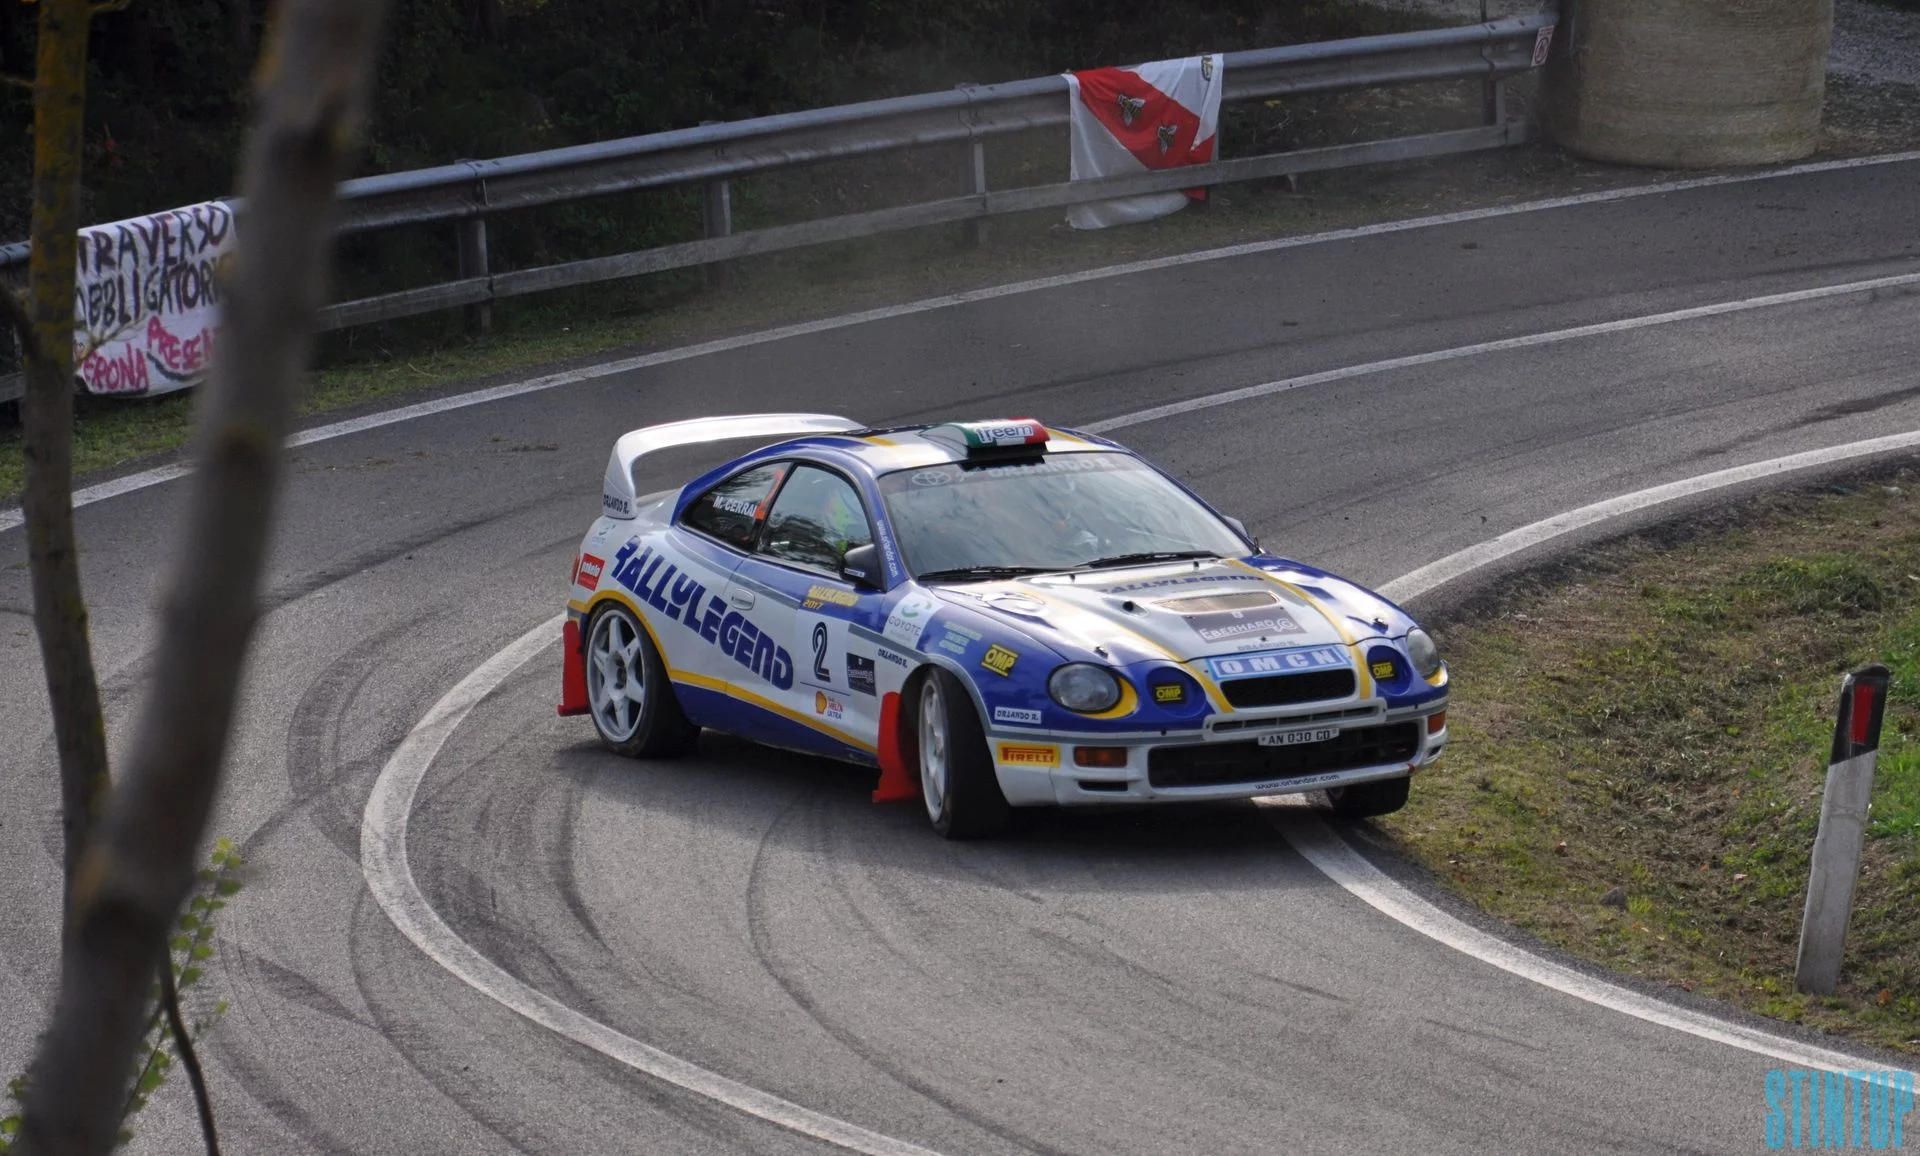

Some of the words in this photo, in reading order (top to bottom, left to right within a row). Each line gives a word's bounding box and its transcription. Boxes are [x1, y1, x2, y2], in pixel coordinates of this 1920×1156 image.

[78, 204, 229, 275] TRAVERSO
[1099, 575, 1264, 595] ALLYLEGEND
[611, 534, 794, 691] RALLYLEGEND
[888, 615, 922, 637] COYOTE
[1200, 619, 1276, 640] EBERHARD
[812, 621, 832, 683] 2
[984, 647, 1016, 673] OMP
[1220, 648, 1337, 674] OMCN
[1373, 663, 1394, 678] OMP
[1156, 687, 1181, 701] OMP
[997, 709, 1030, 721] ORLANDO
[1268, 735, 1284, 745] AN
[1287, 731, 1312, 743] 030
[1002, 747, 1055, 763] PIRELLI
